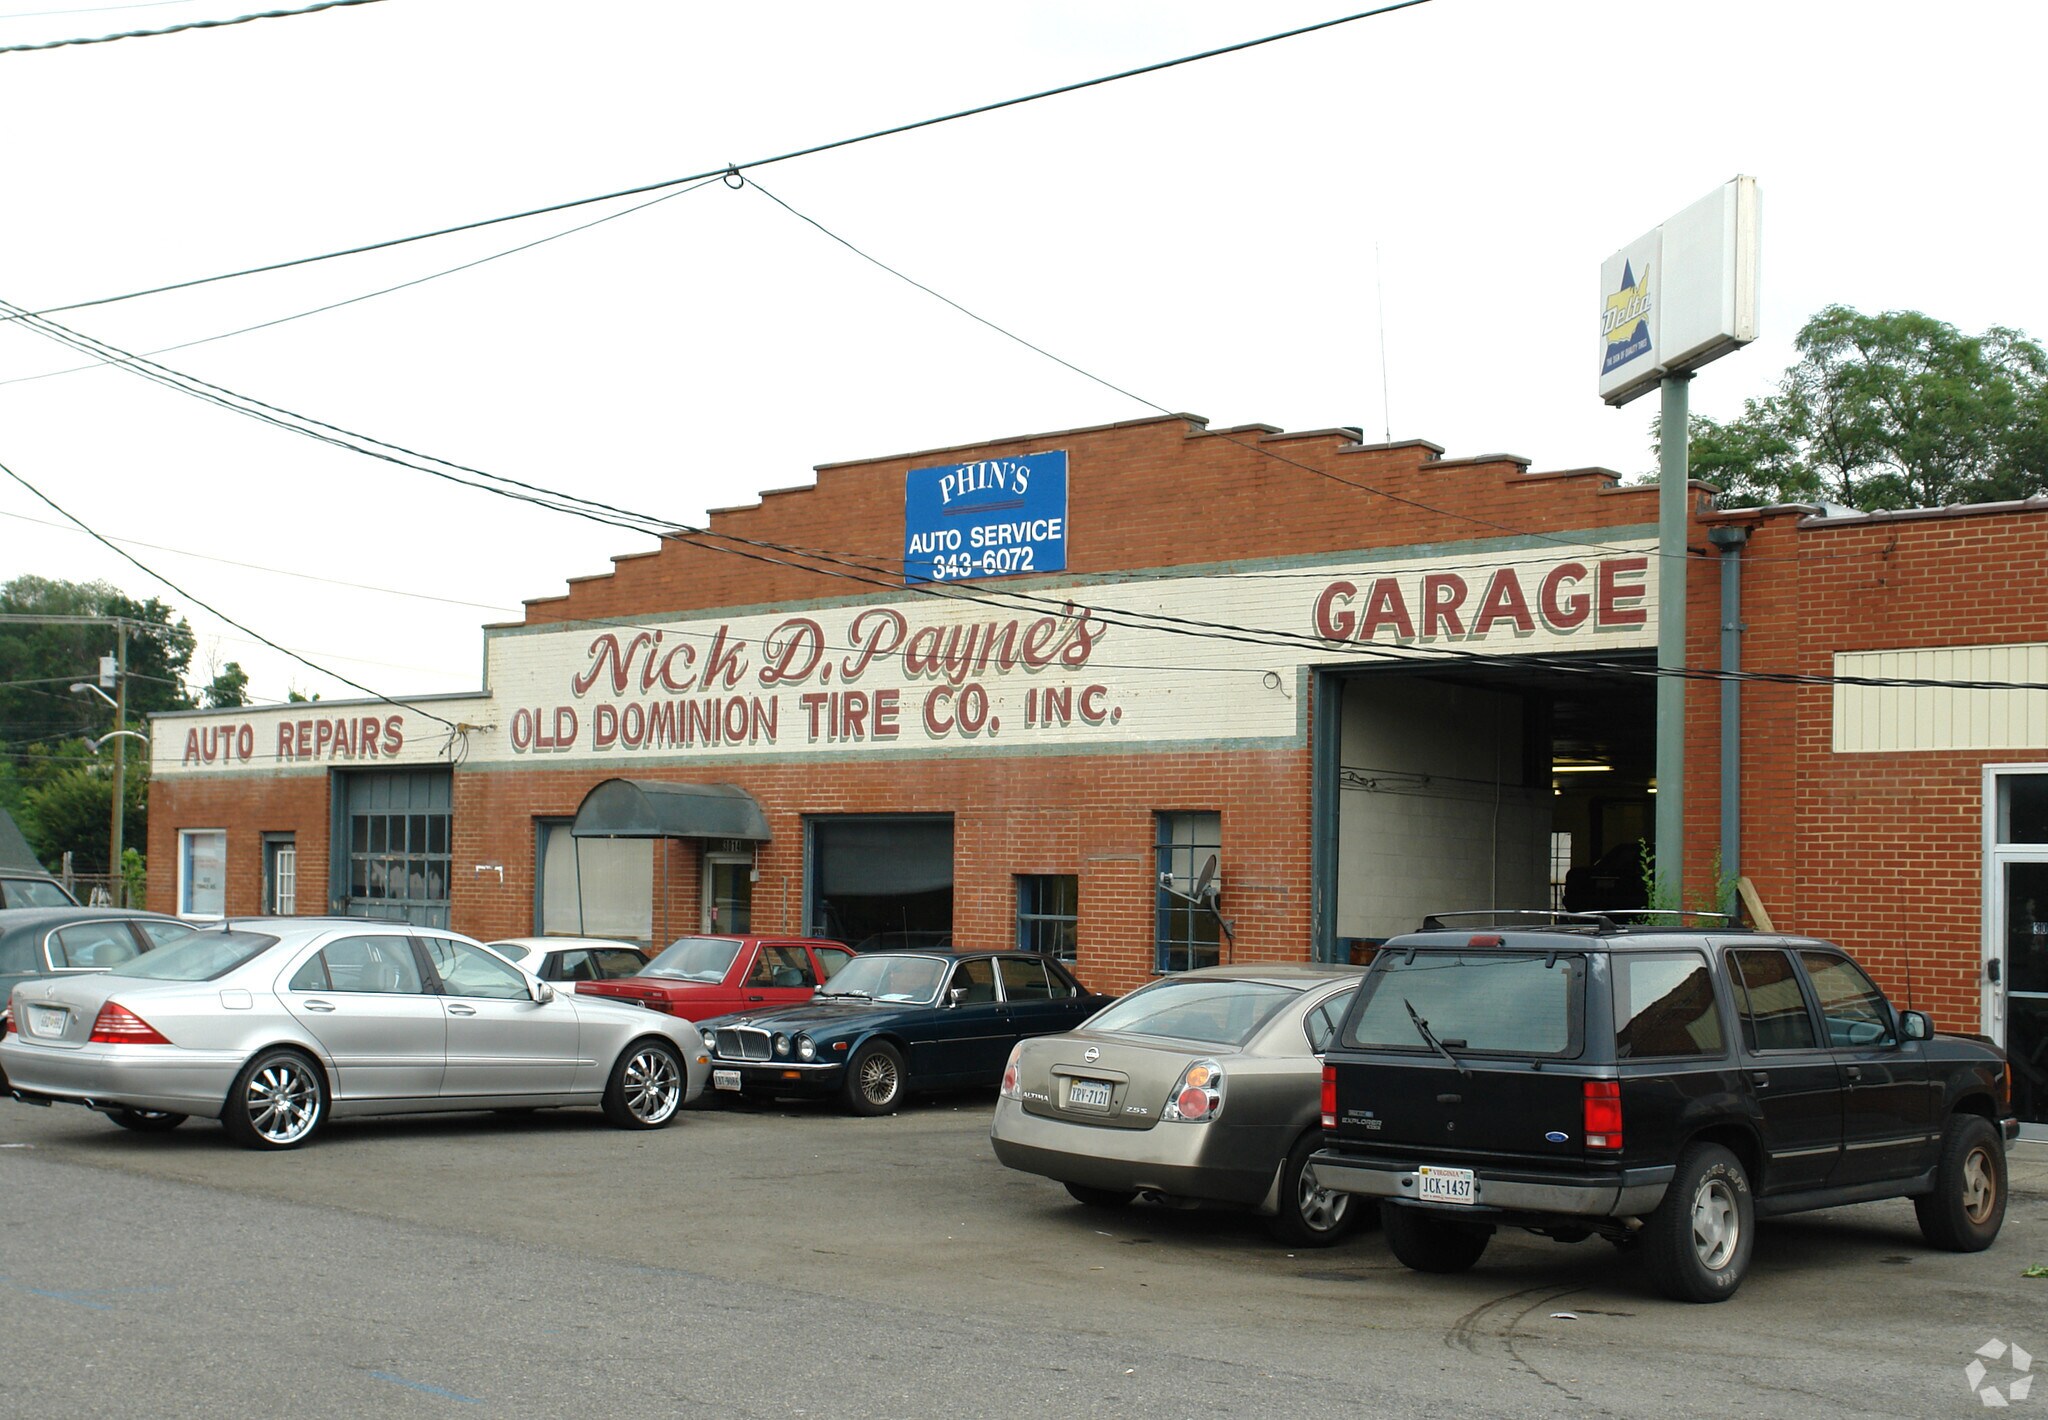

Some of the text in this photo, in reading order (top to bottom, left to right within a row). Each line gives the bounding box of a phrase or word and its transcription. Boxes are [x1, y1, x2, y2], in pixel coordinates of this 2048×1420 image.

[1602, 293, 1651, 337] Delta
[938, 461, 1031, 505] PHIN'S
[909, 518, 1062, 554] AUTO SERVICE
[933, 546, 1034, 579] 343-6072
[572, 625, 749, 698] Nick
[840, 599, 1107, 690] Payne's
[1311, 557, 1648, 649] GARAGE
[510, 683, 1123, 754] OLD DOMINION TIRE CO. INC.
[182, 715, 404, 767] AUTO REPAIRS
[1023, 1092, 1049, 1101] ALTIMA
[1342, 1117, 1382, 1126] EXPLORER
[1423, 1177, 1471, 1196] JCK-1437
[1433, 1169, 1459, 1177] VIRGINIA
